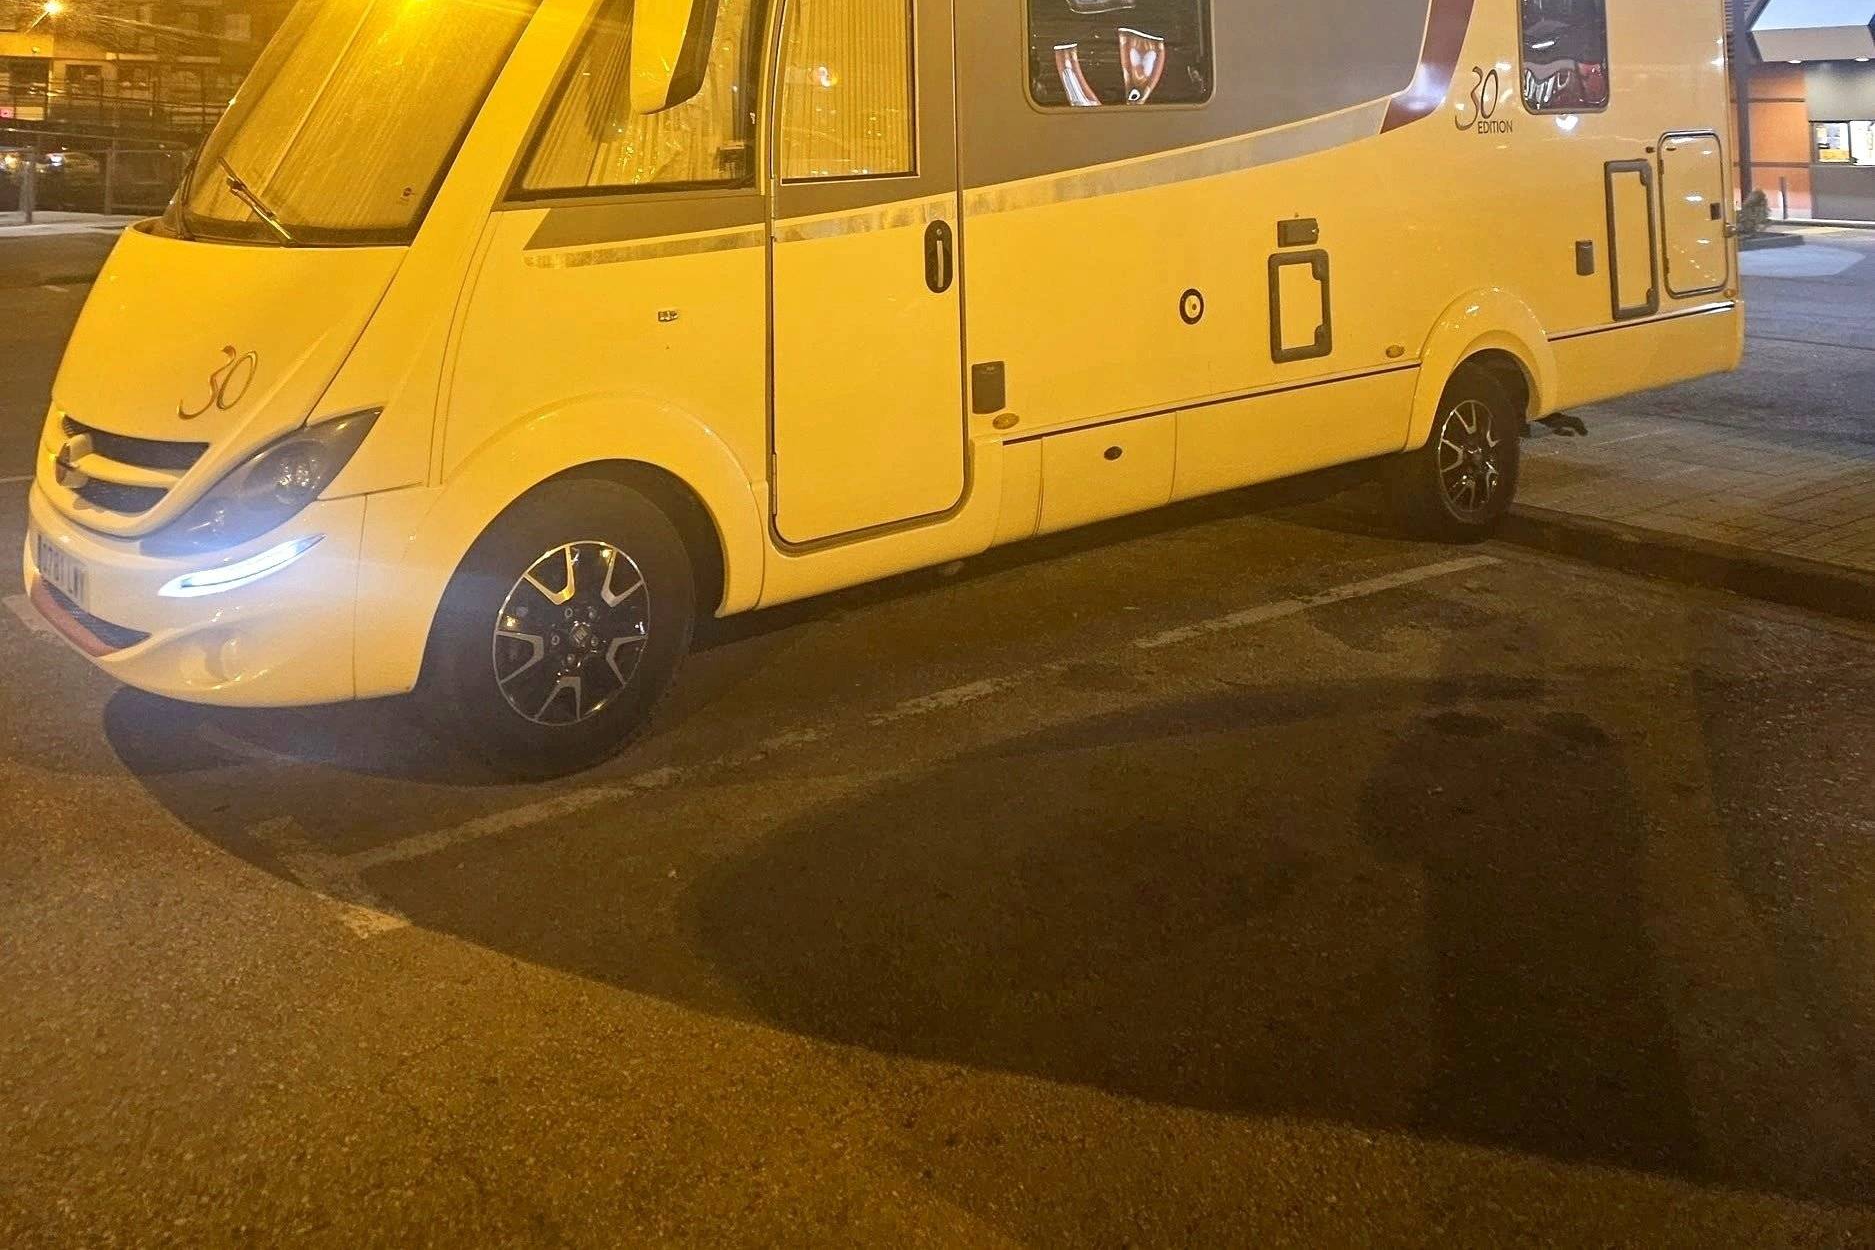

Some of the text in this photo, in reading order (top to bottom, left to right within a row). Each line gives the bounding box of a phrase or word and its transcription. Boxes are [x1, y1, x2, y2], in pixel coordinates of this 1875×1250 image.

[1454, 65, 1499, 131] 30
[1477, 120, 1513, 134] EDITION
[178, 344, 258, 421] 30
